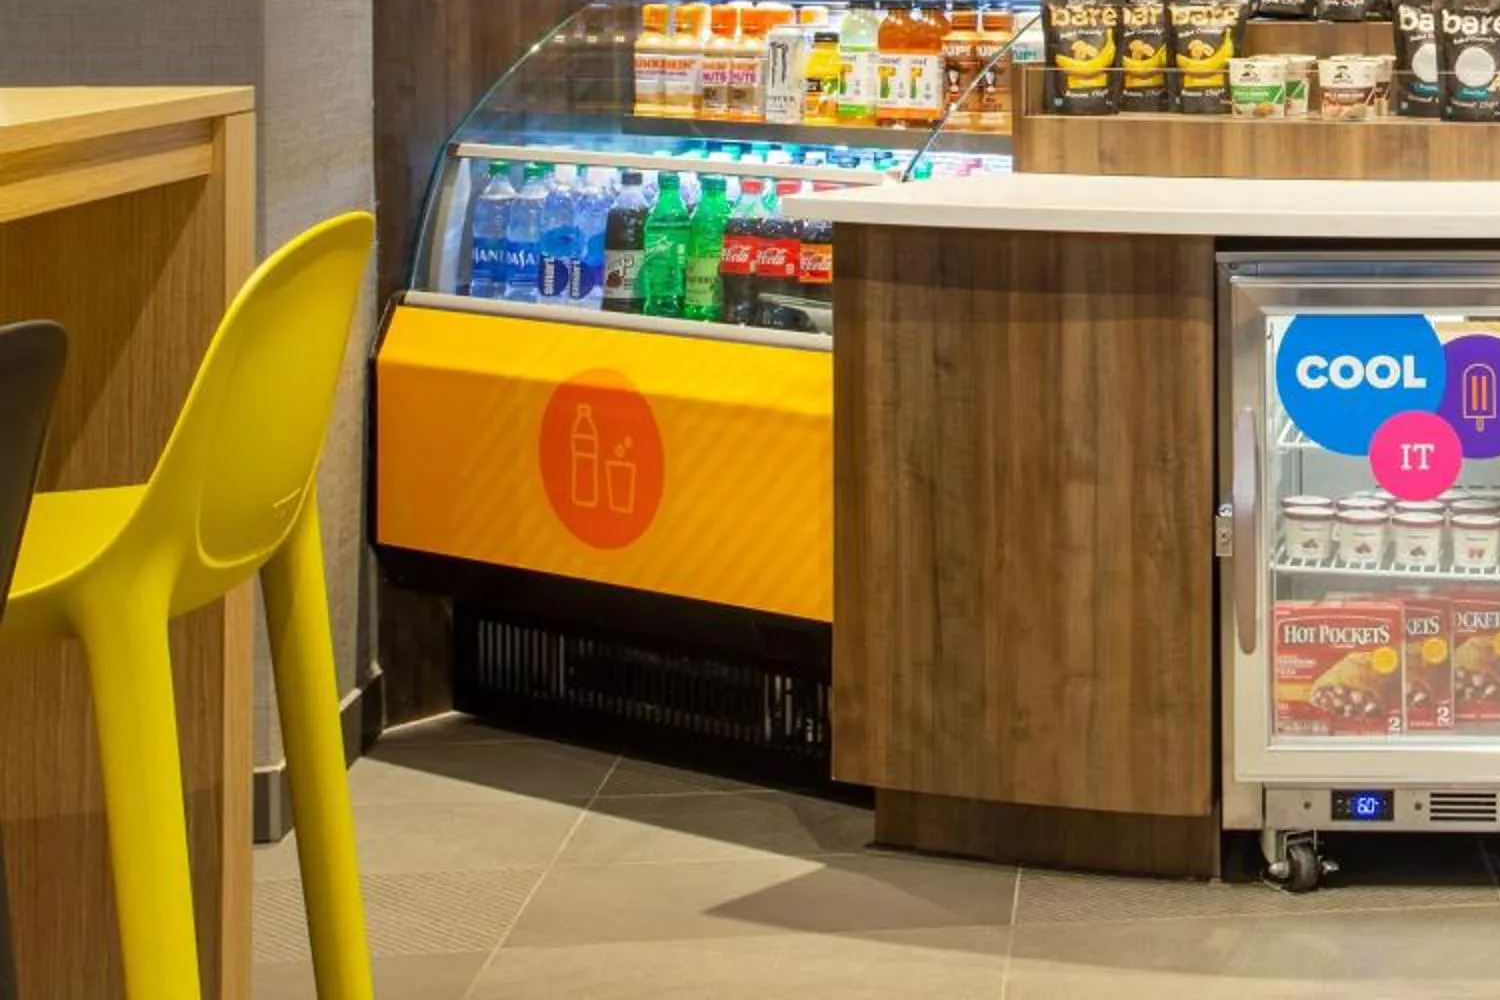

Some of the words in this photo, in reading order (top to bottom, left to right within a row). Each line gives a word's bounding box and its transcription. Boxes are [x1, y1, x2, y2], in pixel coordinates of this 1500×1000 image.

[1047, 2, 1117, 28] bare
[1398, 4, 1435, 32] ba
[1296, 355, 1427, 389] COOL
[1400, 443, 1436, 471] IT
[1283, 624, 1317, 644] HOT
[1319, 624, 1390, 645] POCKETS
[1437, 705, 1452, 727] 2
